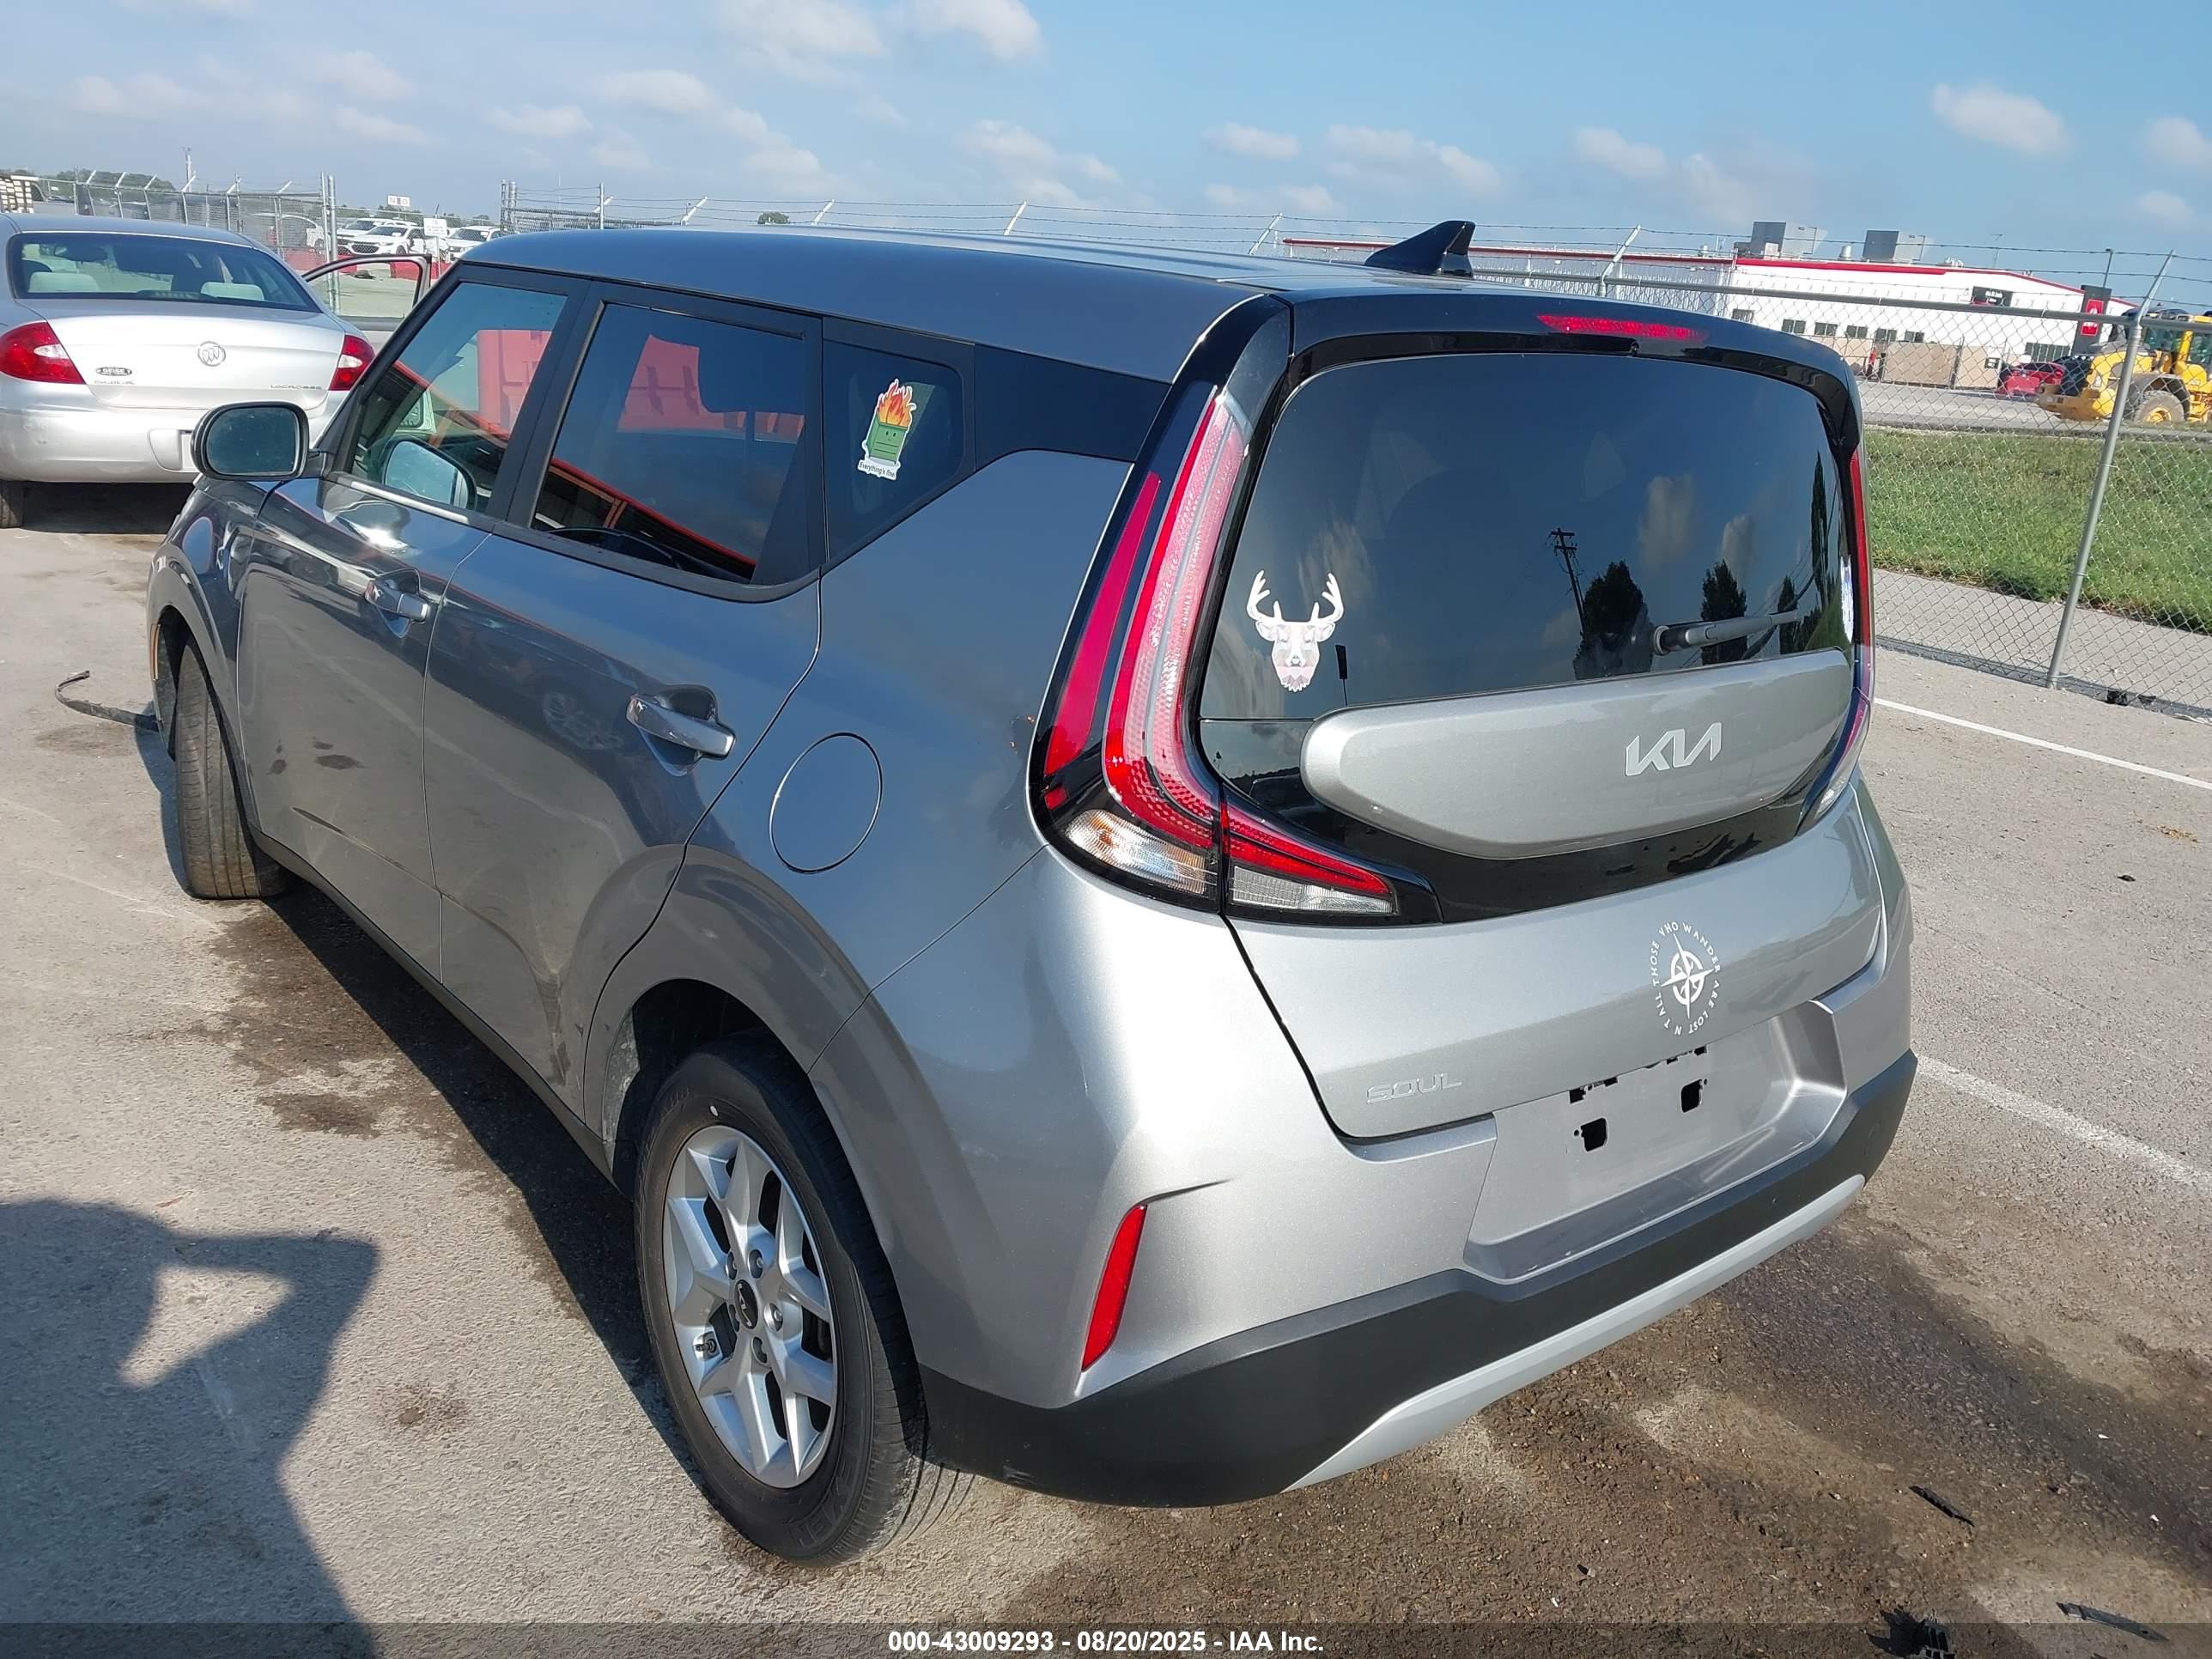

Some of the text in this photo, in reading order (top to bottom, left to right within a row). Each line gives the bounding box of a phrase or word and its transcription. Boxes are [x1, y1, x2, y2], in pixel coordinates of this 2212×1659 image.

[1626, 721, 1723, 776] KIA
[1682, 921, 1721, 973] WANDER
[1650, 940, 1661, 987] THOSE
[1655, 992, 1667, 1017] ALL
[1708, 980, 1720, 1008] ARE
[1688, 1010, 1709, 1036] LOST
[1366, 1073, 1462, 1103] SOUL
